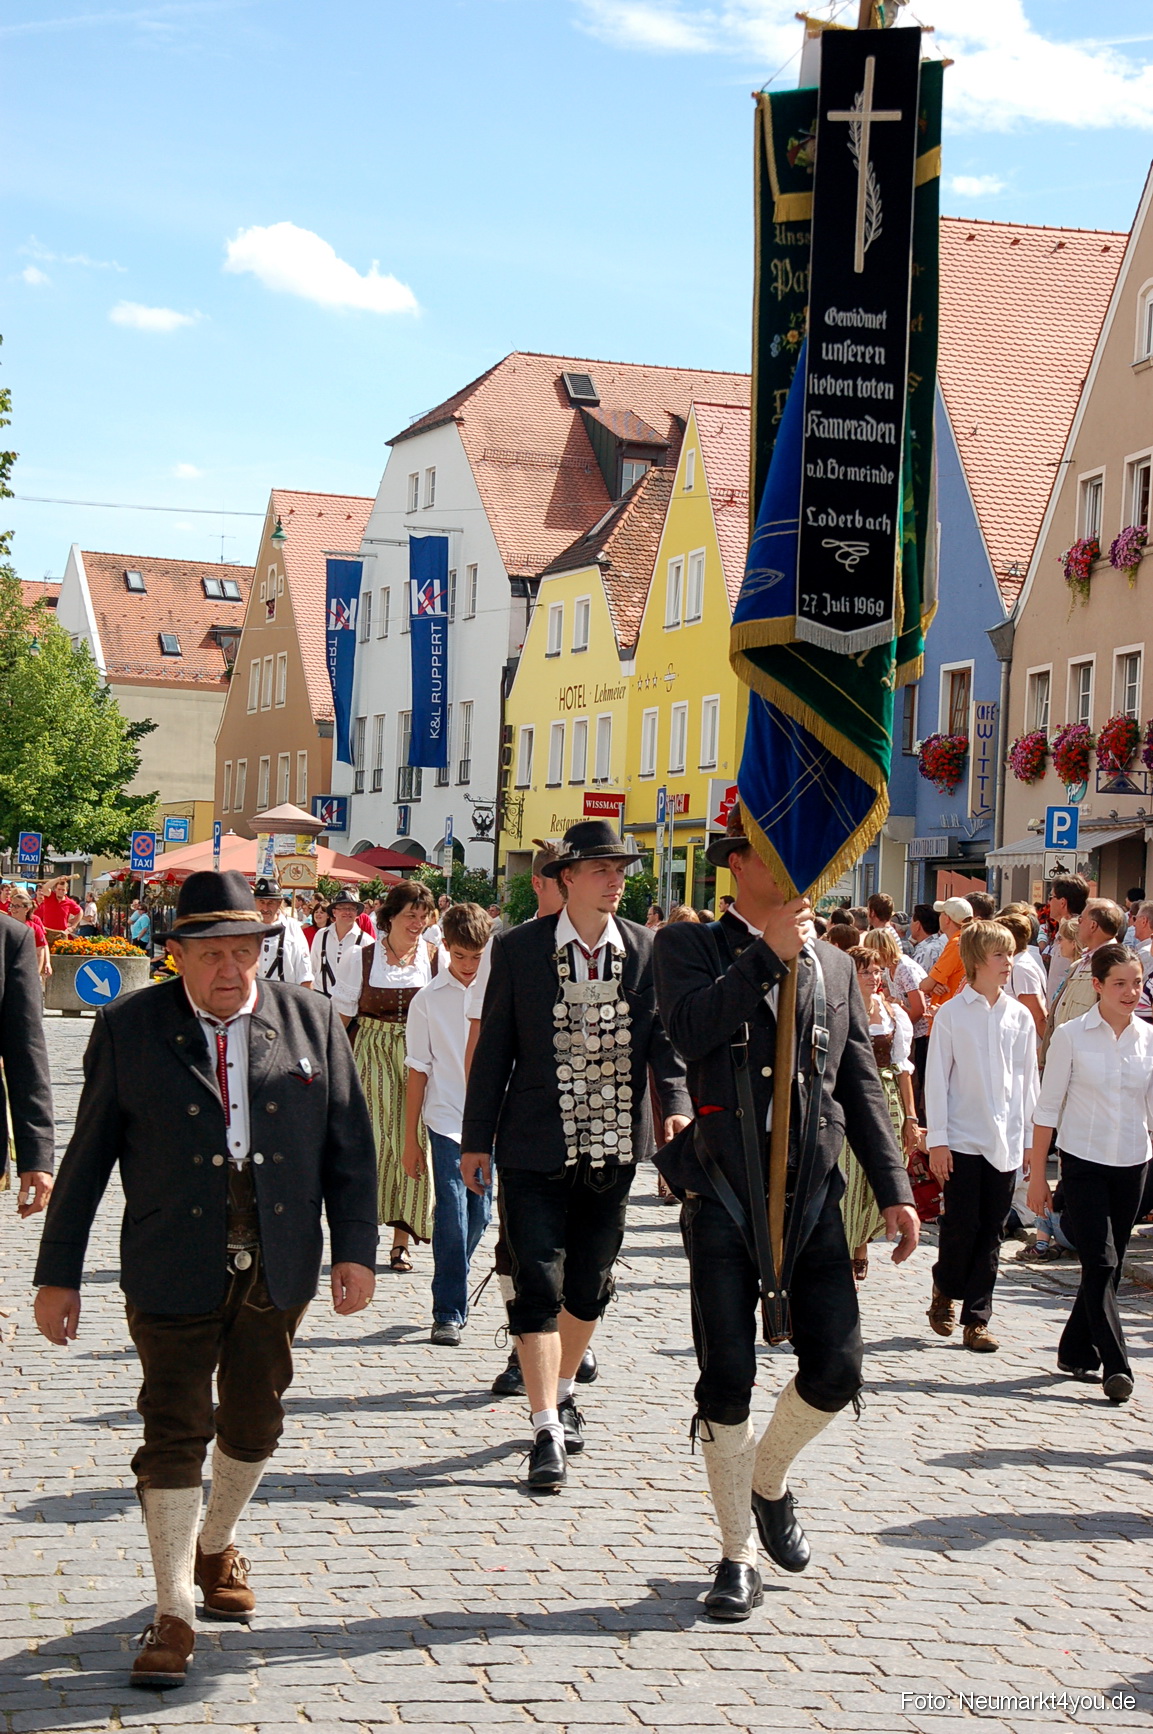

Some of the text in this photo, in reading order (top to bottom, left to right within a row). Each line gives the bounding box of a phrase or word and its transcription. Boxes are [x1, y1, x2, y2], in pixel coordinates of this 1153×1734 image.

[824, 306, 887, 330] Gewidmet
[810, 373, 853, 397] lieben
[856, 376, 894, 400] toten
[805, 410, 896, 445] Kameraden
[806, 506, 892, 536] Loderbach
[822, 593, 850, 616] Juli
[854, 596, 884, 617] 1969
[431, 622, 443, 703] RUPPERT
[558, 684, 587, 711] HOTEL
[593, 680, 627, 704] Lehmeier
[976, 703, 996, 721] CAFÉ
[976, 723, 993, 809] WITTL
[1051, 810, 1072, 844] P
[20, 853, 38, 863] TAXI
[132, 858, 153, 868] TAXI
